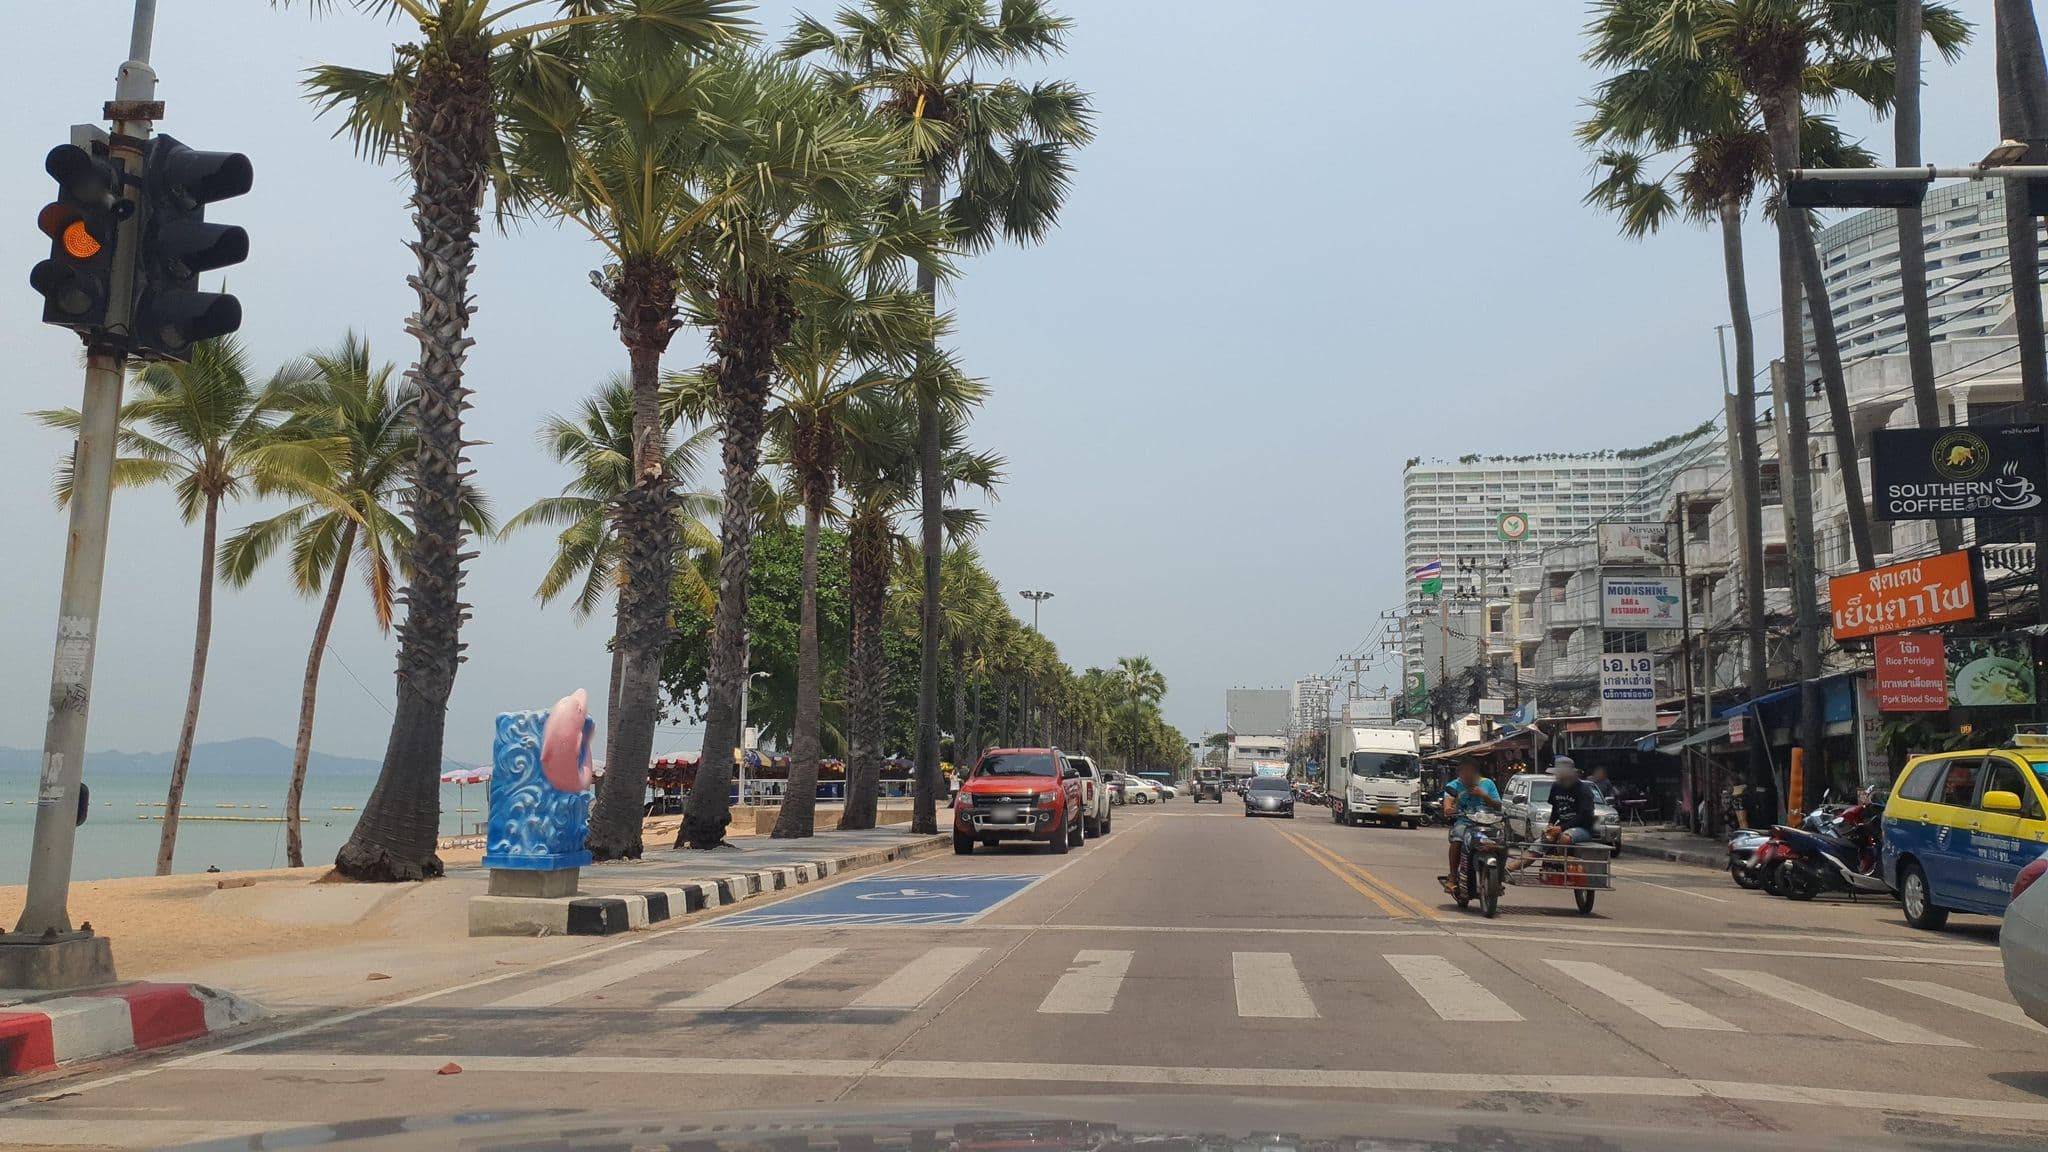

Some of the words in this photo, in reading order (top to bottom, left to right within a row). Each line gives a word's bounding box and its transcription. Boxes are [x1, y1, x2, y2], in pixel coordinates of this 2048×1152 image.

[1888, 481, 1993, 499] SOUTHERN
[1890, 497, 1965, 514] COFFEE
[1608, 586, 1669, 596] MOONSHINE
[1611, 607, 1650, 615] RESTAURANT
[1835, 580, 1970, 630] เย็นตาโฟ
[1603, 658, 1651, 672] เอ.เอ
[1886, 657, 1902, 666] Rice
[1903, 656, 1935, 667] Porridge
[1882, 695, 1899, 704] Pork
[1901, 694, 1923, 704] Blood
[1924, 694, 1945, 705] Soup
